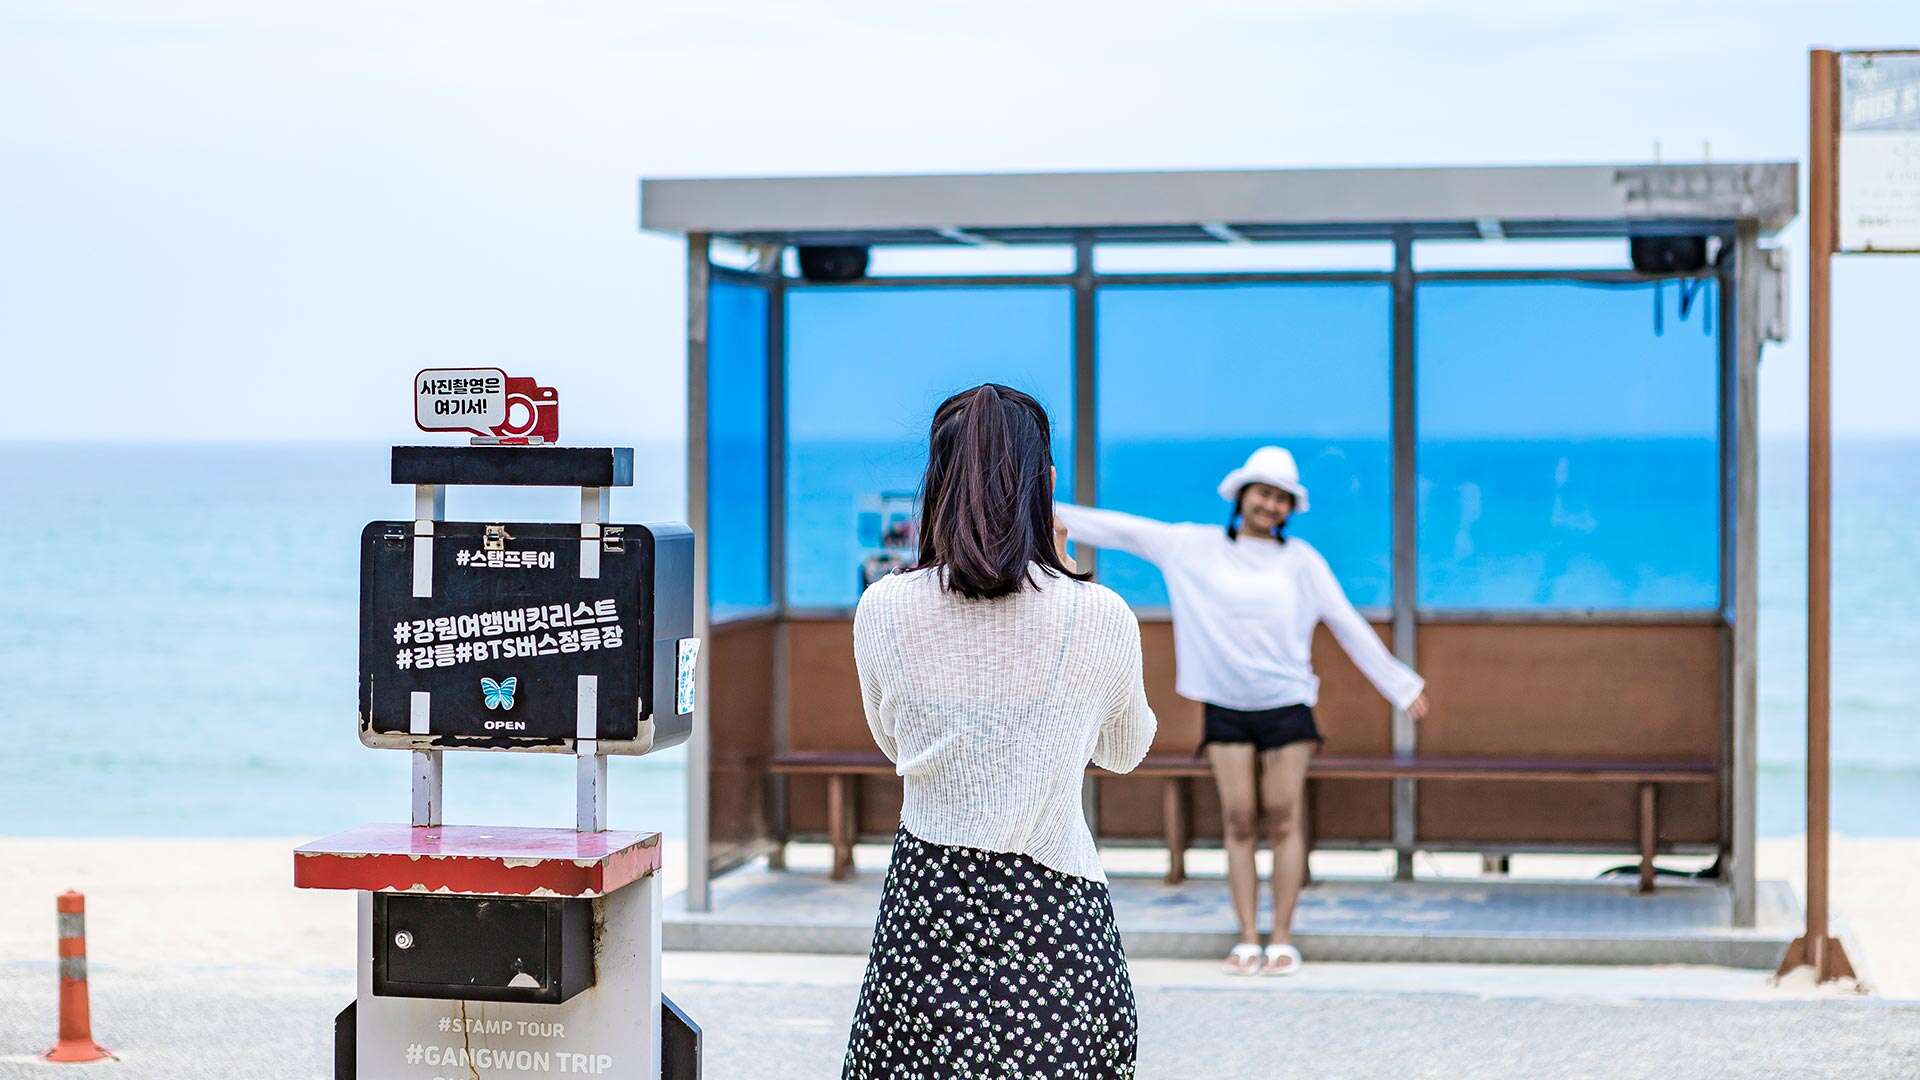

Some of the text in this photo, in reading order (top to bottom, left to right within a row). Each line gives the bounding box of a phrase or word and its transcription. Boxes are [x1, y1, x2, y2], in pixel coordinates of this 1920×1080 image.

[420, 377, 500, 395] 사진촬영은
[434, 398, 487, 415] 여기서!
[456, 549, 555, 569] #스탬프투어
[393, 599, 619, 645] #강원여행버킷리스트
[396, 625, 624, 670] #강릉#BTS버스정류장
[484, 720, 526, 731] OPEN
[438, 1016, 565, 1038] #STAMP TOUR
[405, 1043, 613, 1074] #GANGWON TRIP
